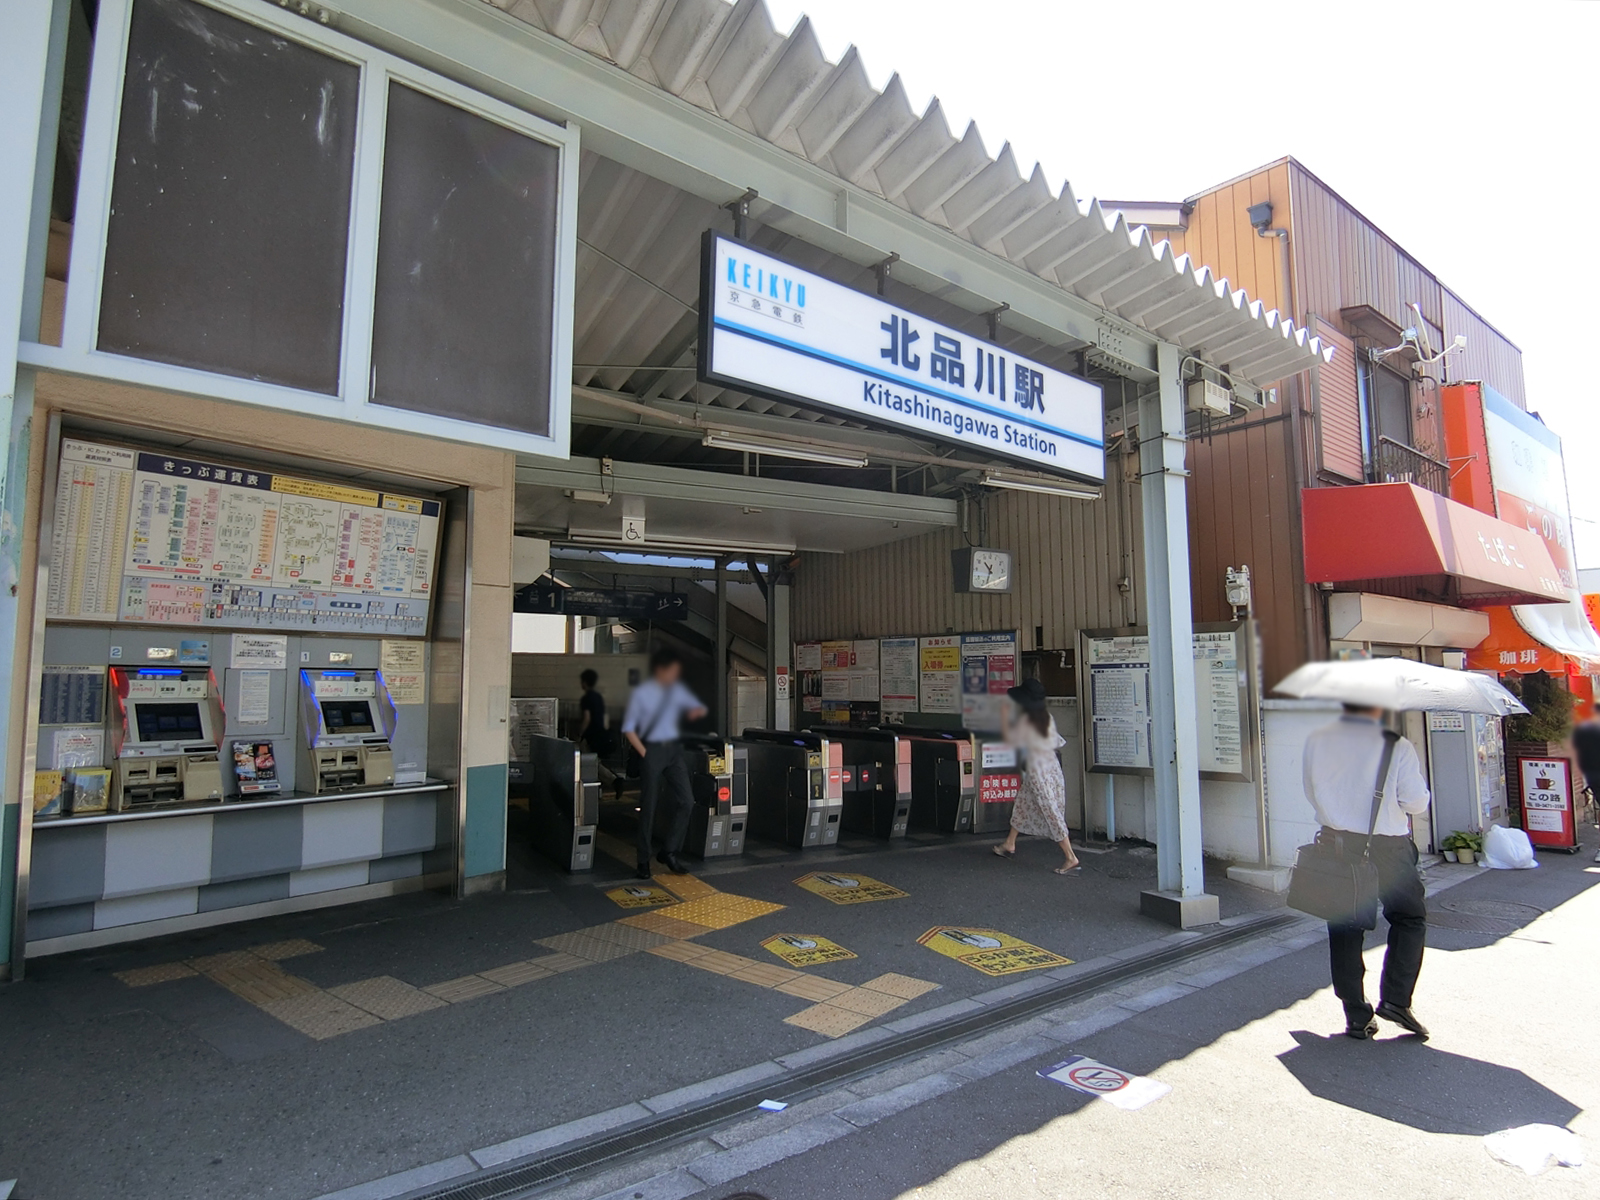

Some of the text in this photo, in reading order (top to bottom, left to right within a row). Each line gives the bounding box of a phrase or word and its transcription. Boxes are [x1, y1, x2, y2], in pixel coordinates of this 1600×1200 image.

[728, 257, 806, 308] KEIKYU
[730, 290, 803, 326] 京急電鉄
[880, 314, 1045, 414] 北品川駅
[863, 380, 1057, 456] Kitashinagawa Station
[163, 461, 259, 486] きっぷ運賃表
[1477, 531, 1524, 569] たばこ
[547, 592, 556, 608] 1
[111, 647, 121, 656] 2
[928, 638, 952, 646] お知らせ
[1499, 649, 1538, 664] 珈琲
[983, 778, 1017, 788] 危険物品
[1528, 792, 1561, 802] この路
